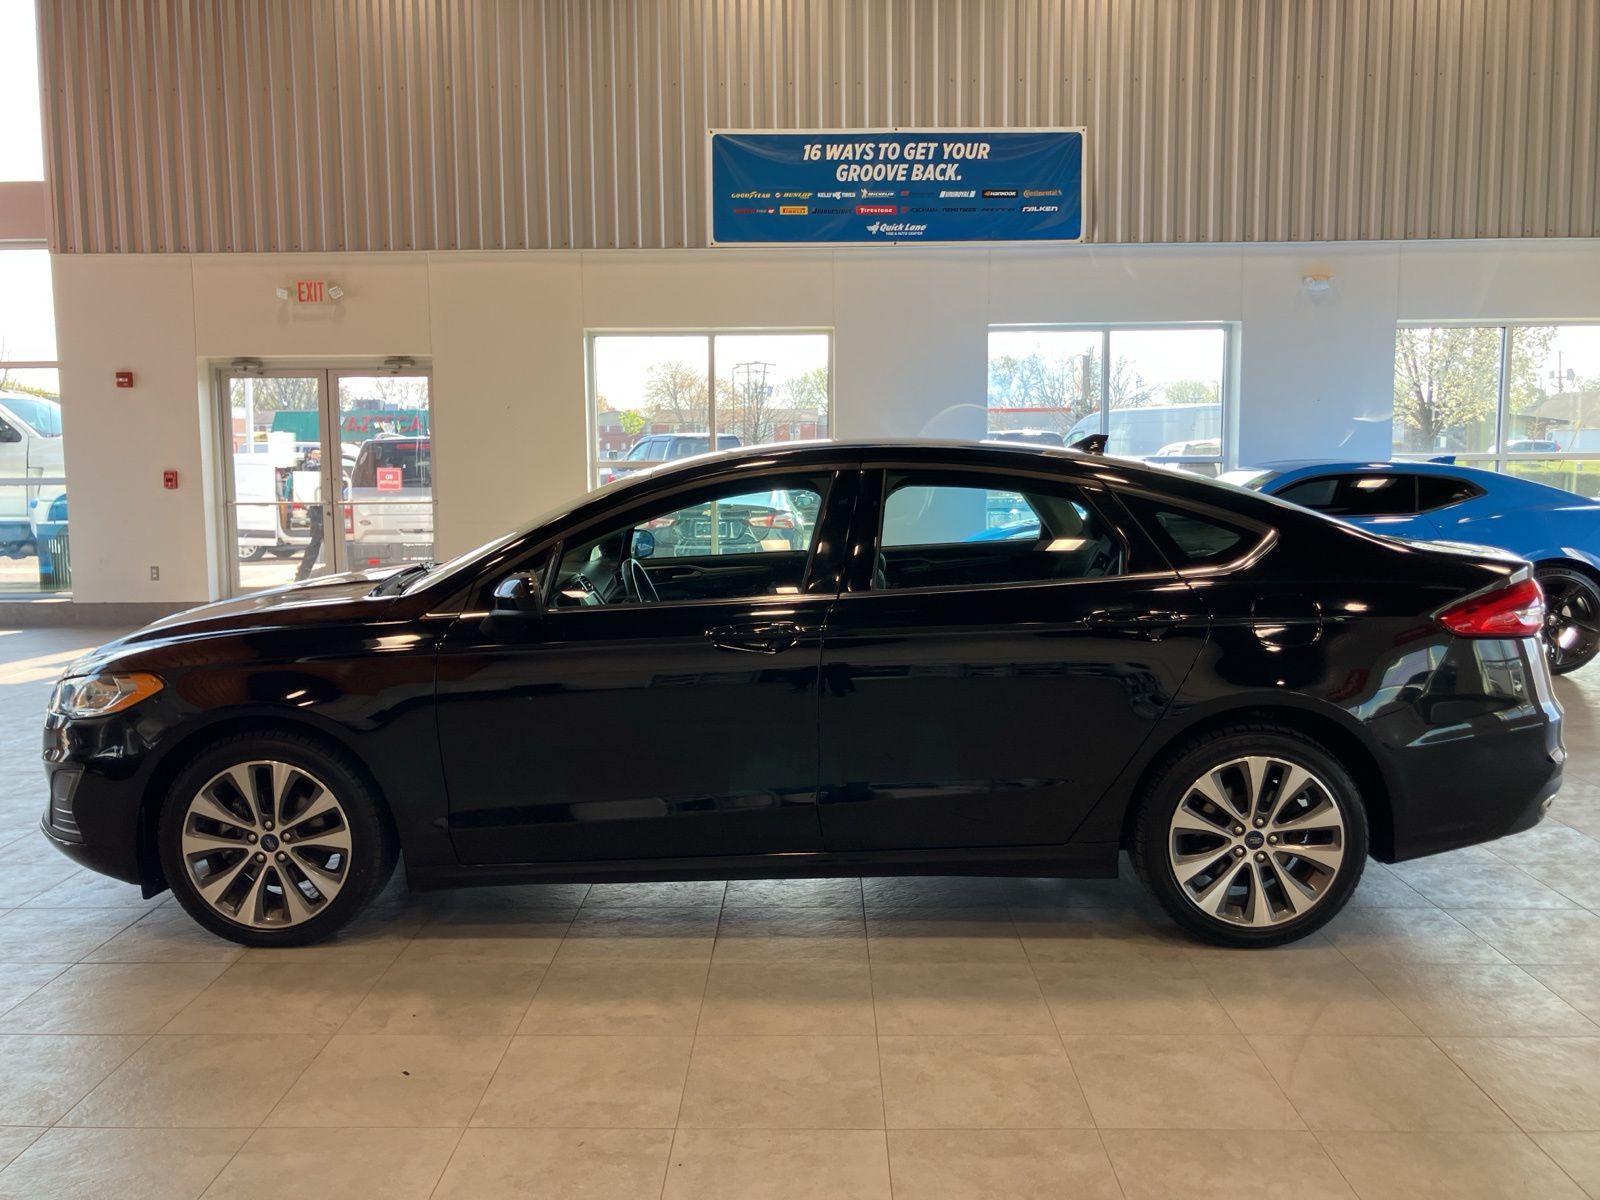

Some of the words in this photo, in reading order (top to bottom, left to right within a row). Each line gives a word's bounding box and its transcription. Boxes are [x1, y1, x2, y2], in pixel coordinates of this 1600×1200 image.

[803, 144, 822, 160] 16
[826, 144, 875, 160] WAYS
[878, 143, 900, 160] TO
[904, 142, 938, 160] GET
[943, 142, 990, 160] YOUR
[836, 164, 908, 182] GROOVE
[911, 163, 962, 180] BACK.
[783, 192, 813, 200] DUNLOP
[1023, 190, 1058, 198] Continental
[880, 223, 904, 232] Quick
[904, 223, 927, 231] Lane
[298, 281, 324, 302] EXIT
